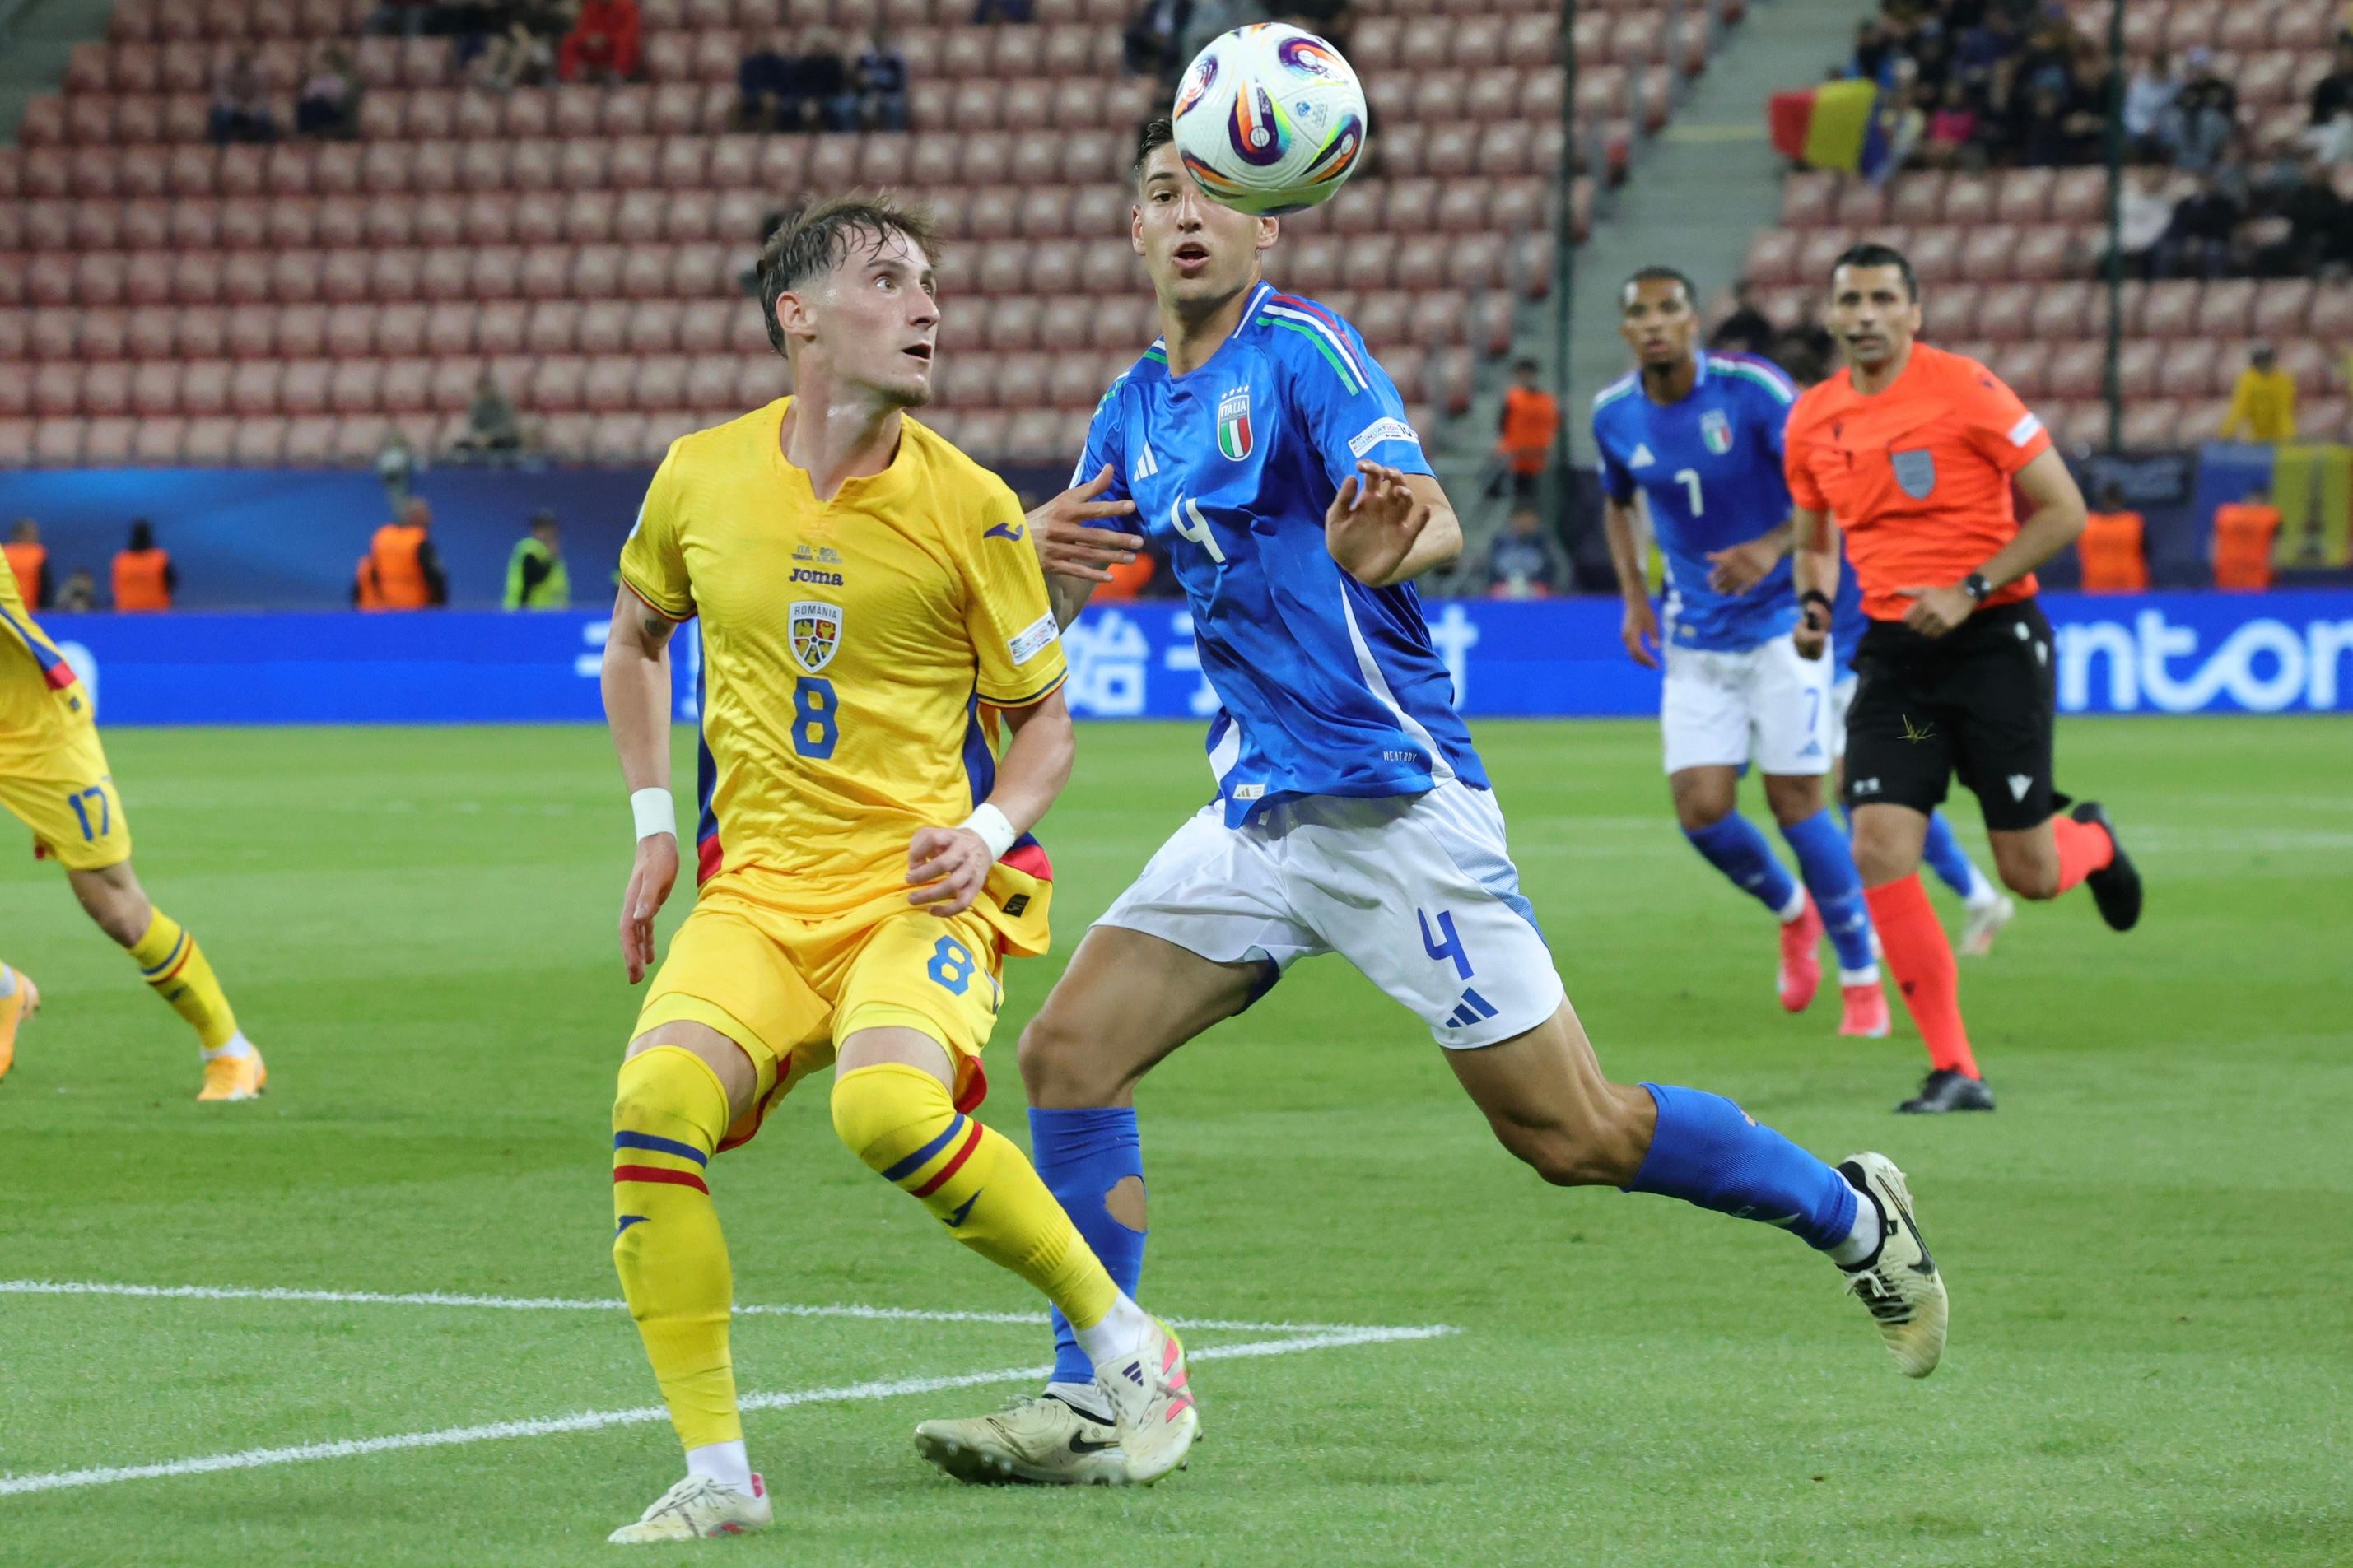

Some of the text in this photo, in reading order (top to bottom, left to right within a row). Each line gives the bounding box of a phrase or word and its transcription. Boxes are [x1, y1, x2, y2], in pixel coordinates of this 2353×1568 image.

[1221, 399, 1246, 418] ITALIA
[1674, 468, 1704, 517] 7
[1170, 492, 1226, 563] 4
[794, 605, 837, 619] ROMANIA
[790, 676, 839, 759] 8
[68, 786, 109, 842] 17
[928, 935, 976, 996] 8
[1417, 907, 1475, 981] 4
